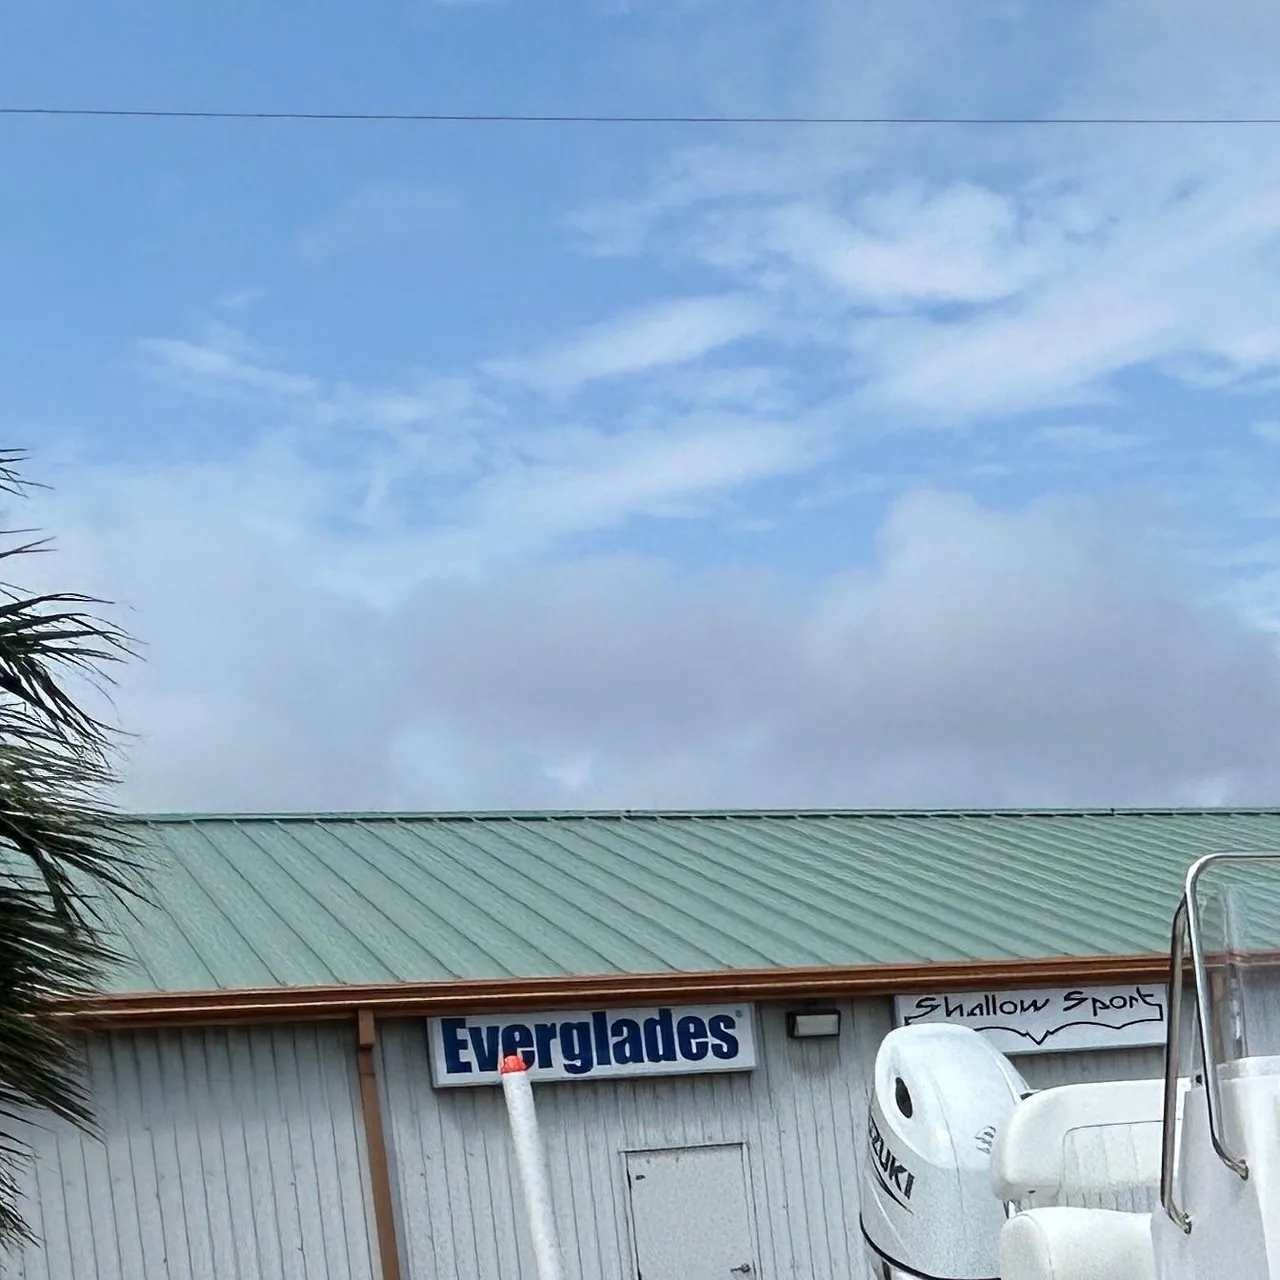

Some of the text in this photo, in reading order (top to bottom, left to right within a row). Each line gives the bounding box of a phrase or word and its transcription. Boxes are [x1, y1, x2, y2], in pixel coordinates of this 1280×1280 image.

[906, 986, 1155, 1018] Shallow Sport
[440, 1007, 740, 1075] Everglades
